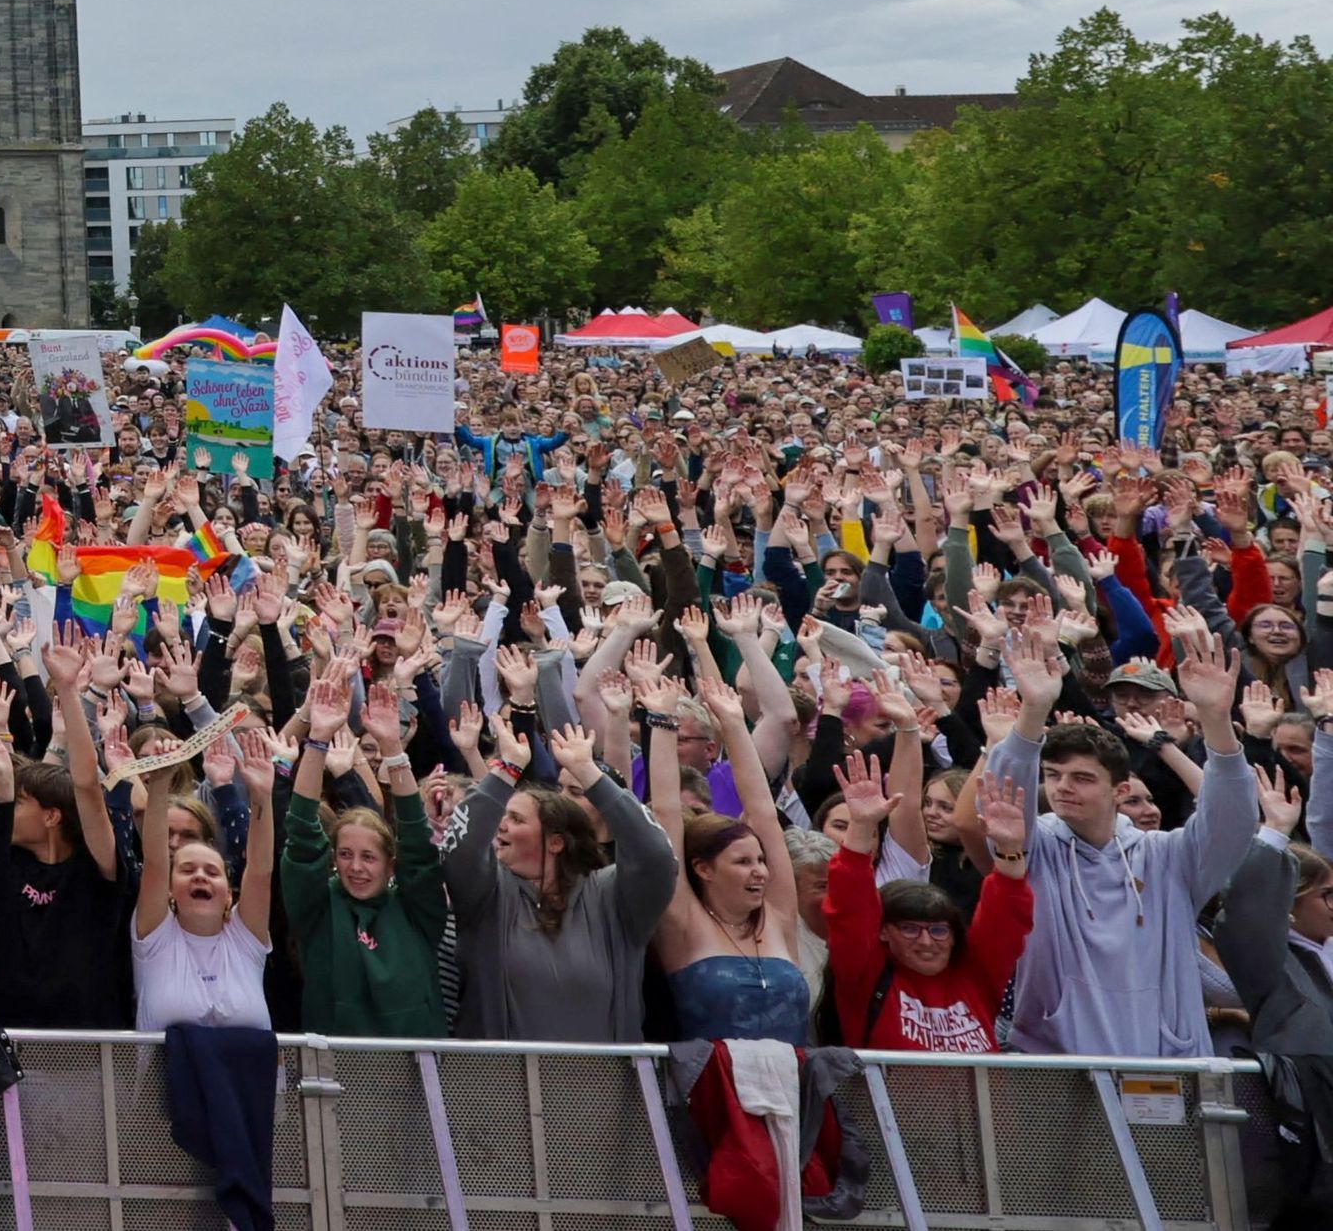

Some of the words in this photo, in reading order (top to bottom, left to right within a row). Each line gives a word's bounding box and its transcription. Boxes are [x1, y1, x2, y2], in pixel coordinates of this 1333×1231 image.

[49, 352, 90, 363] Grauland
[384, 355, 449, 370] aktions
[395, 368, 449, 383] bündnis
[1139, 369, 1151, 421] HALTEN!
